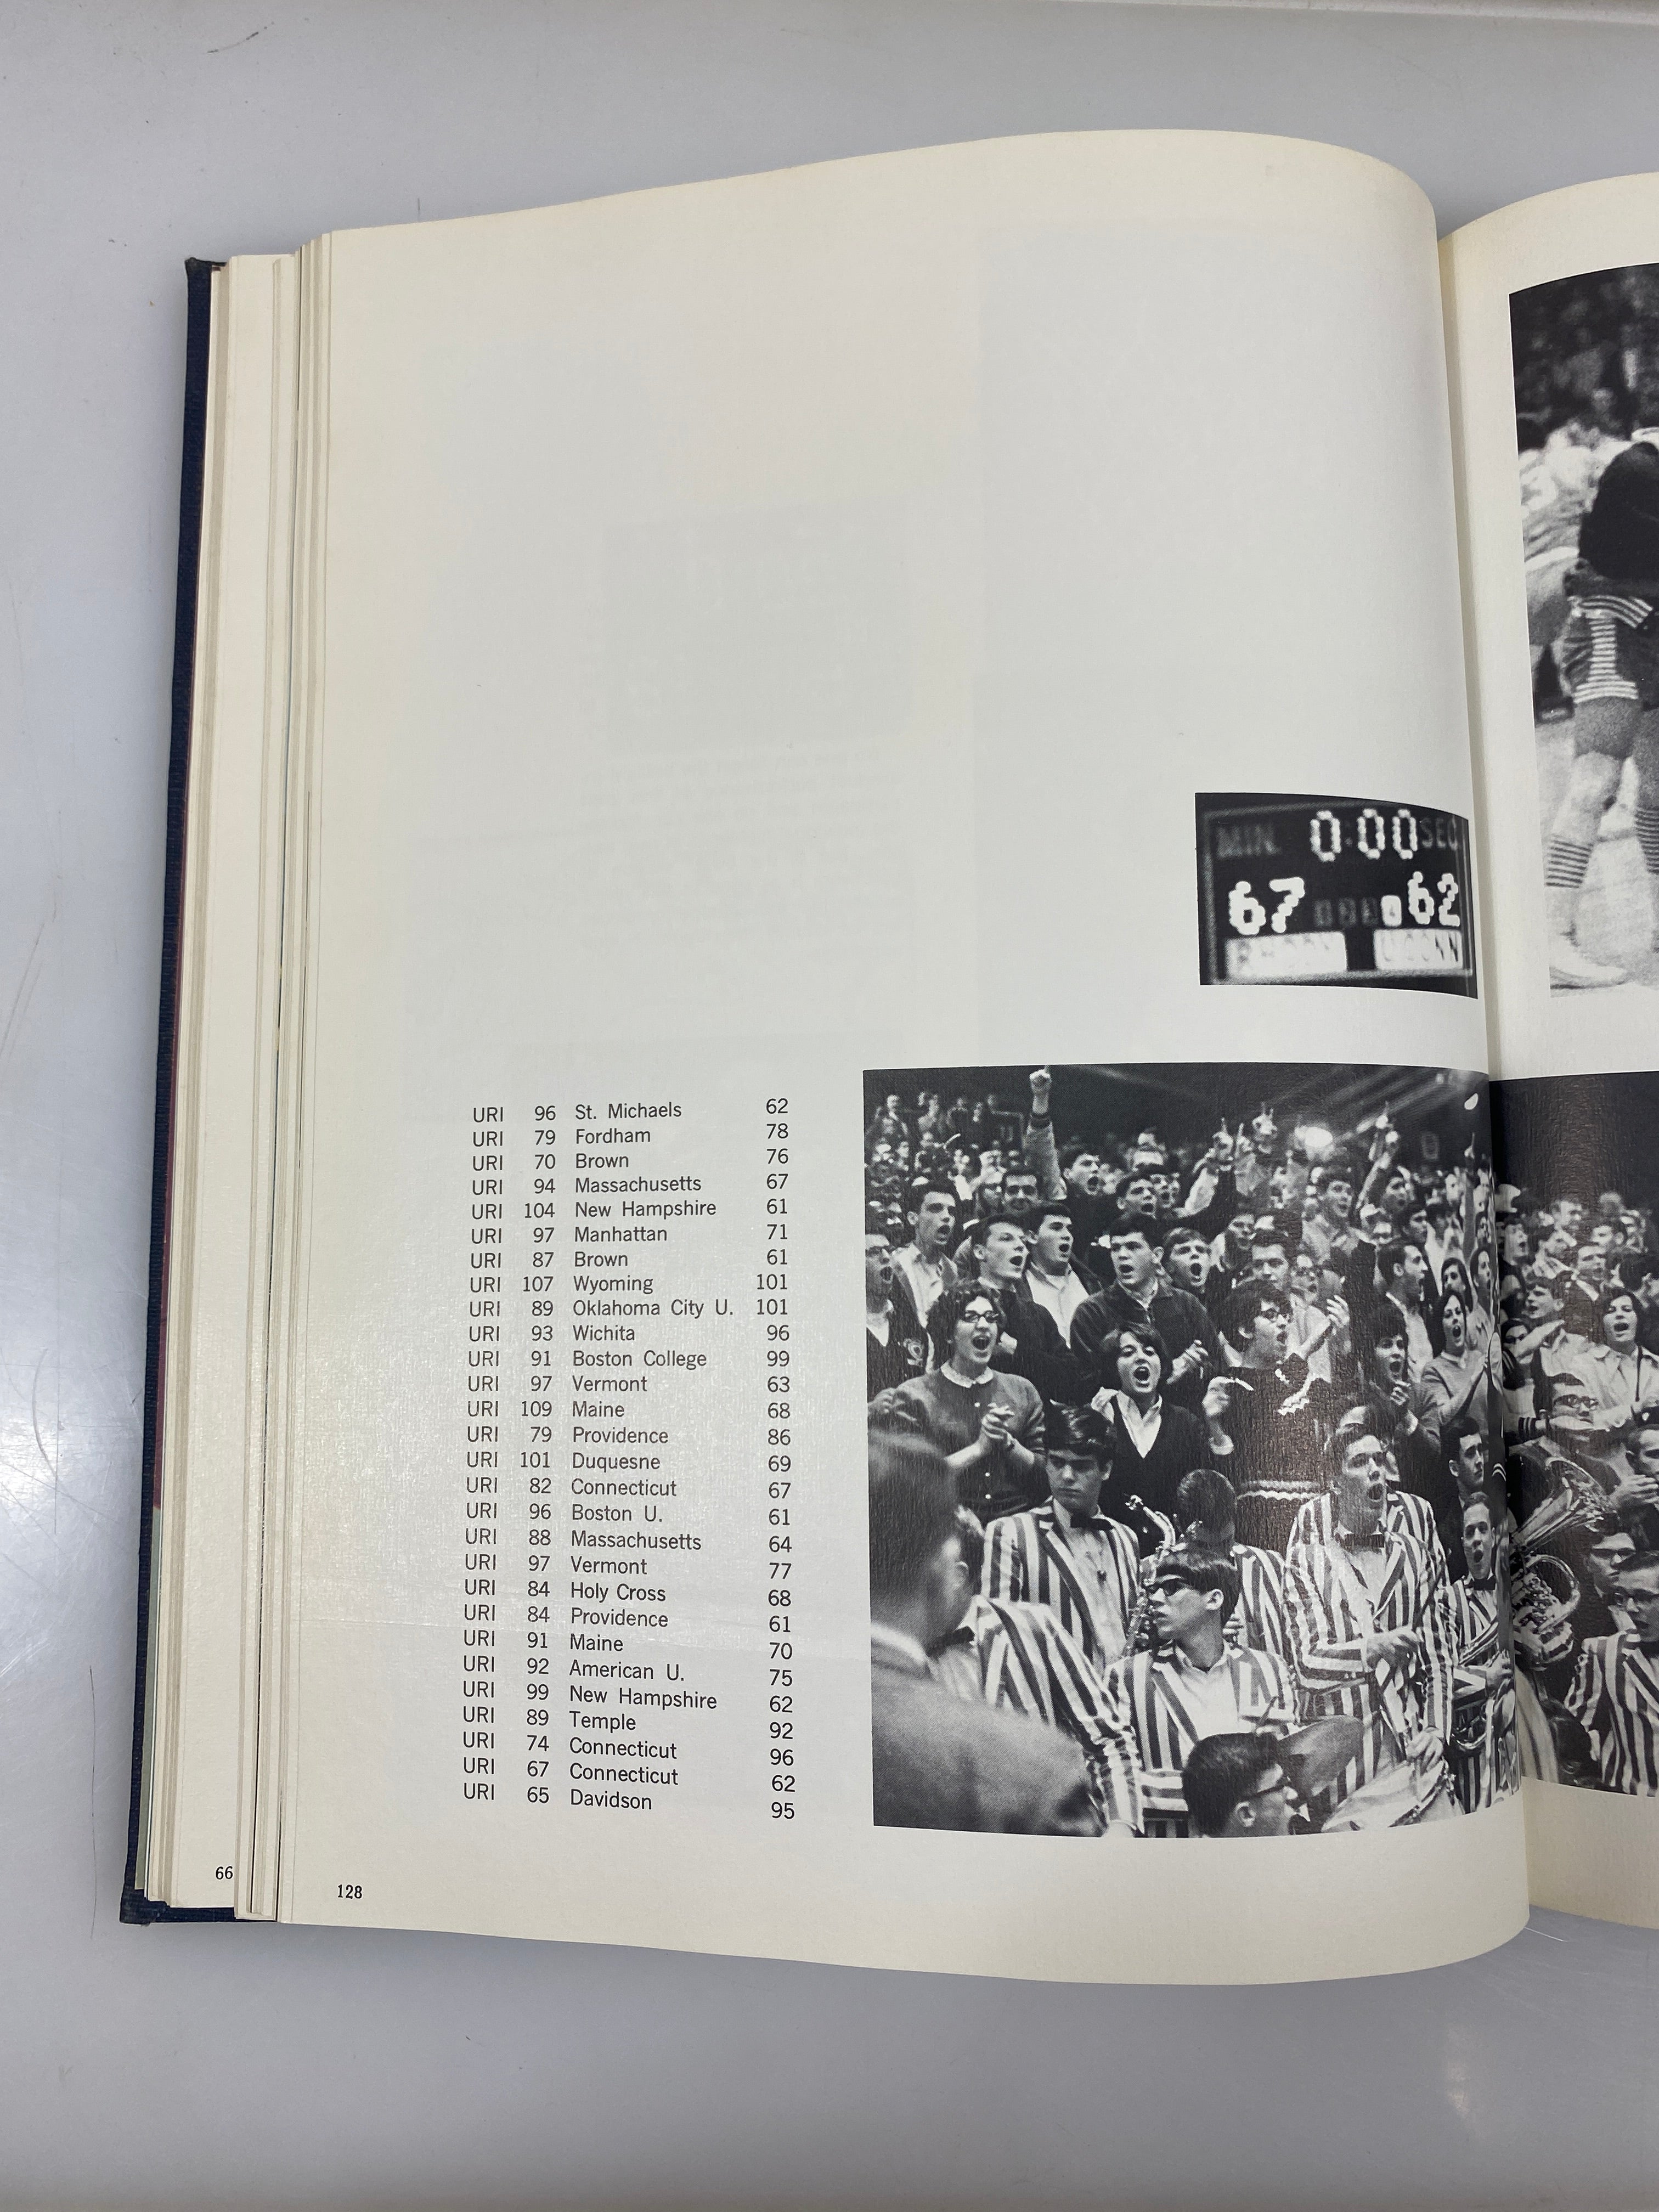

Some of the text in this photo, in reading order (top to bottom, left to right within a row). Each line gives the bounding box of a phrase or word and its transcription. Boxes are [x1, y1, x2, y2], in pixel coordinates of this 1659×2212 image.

[1228, 877, 1305, 935] 67
[1408, 871, 1460, 927] 62
[473, 1098, 788, 1123] URI 96 St. Michaels 62
[473, 1122, 789, 1147] URI 79 Fordham 78
[472, 1148, 789, 1171] URI 70 Brown 76
[472, 1173, 788, 1195] URI 94 Massachusetts 67
[472, 1198, 788, 1220] URI 104 New Hampshire 61
[471, 1223, 788, 1244] URI 97 Manhattan 71
[471, 1249, 788, 1269] URI 87 Brown 61
[470, 1273, 788, 1296] URI 107 Wyoming 101
[470, 1299, 788, 1319] URI 89 Oklahoma City U. 101
[469, 1324, 790, 1342] URI 93 Wichita 96
[469, 1350, 790, 1370] URI 91 Boston College 99
[468, 1375, 790, 1393] URI 97 Vermont 63
[467, 1400, 791, 1419] URI 109 Maine 68
[467, 1425, 791, 1446] URI 79 Providence 86
[467, 1451, 791, 1473] URI 101 Duquesne 69
[466, 1476, 791, 1499] URI 82 Connecticut 67
[466, 1502, 791, 1526] URI 96 Boston U. 61
[465, 1527, 793, 1553] URI 88 Massachusetts 64
[465, 1553, 792, 1579] URI 97 Vermont 77
[465, 1578, 792, 1607] URI 84 Holy Cross 68
[464, 1604, 791, 1633] URI 84 Providence 61
[464, 1629, 793, 1660] URI 91 Maine 70
[464, 1655, 793, 1687] URI 92 American U. 75
[463, 1680, 793, 1713] URI 99 New Hampshire 62
[463, 1706, 793, 1740] URI 89 Temple 92
[463, 1731, 794, 1767] URI 74 Connecticut 96
[464, 1757, 795, 1793] URI 67 Connecticut 62
[464, 1782, 795, 1820] URI 65 Davidson 95
[215, 1866, 233, 1880] 66
[337, 1884, 363, 1899] 128
